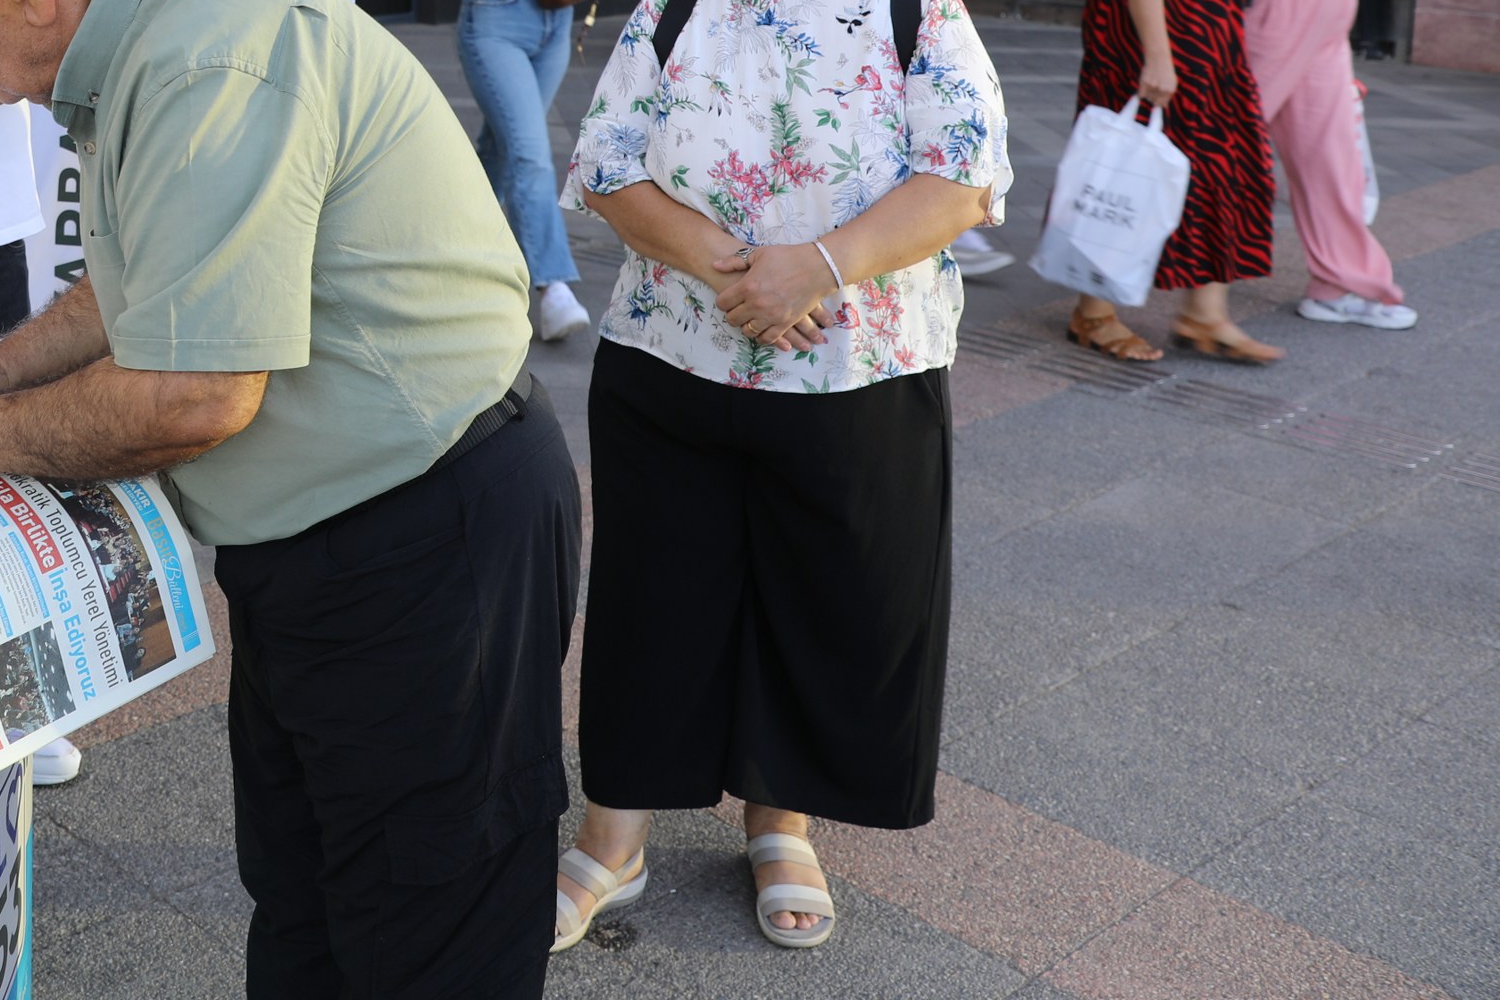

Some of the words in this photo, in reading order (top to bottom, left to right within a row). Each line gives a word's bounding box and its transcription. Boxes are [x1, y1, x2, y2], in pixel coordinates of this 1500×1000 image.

[1072, 199, 1136, 231] MARK
[126, 481, 151, 509] AKIR
[2, 470, 51, 510] okratik
[45, 508, 89, 581] Toplumcu
[80, 580, 101, 622] Yerel
[94, 619, 124, 689] Yönetimi
[8, 501, 57, 569] Birlikte
[46, 566, 71, 613] İnşa
[63, 614, 98, 700] Ediyoruz
